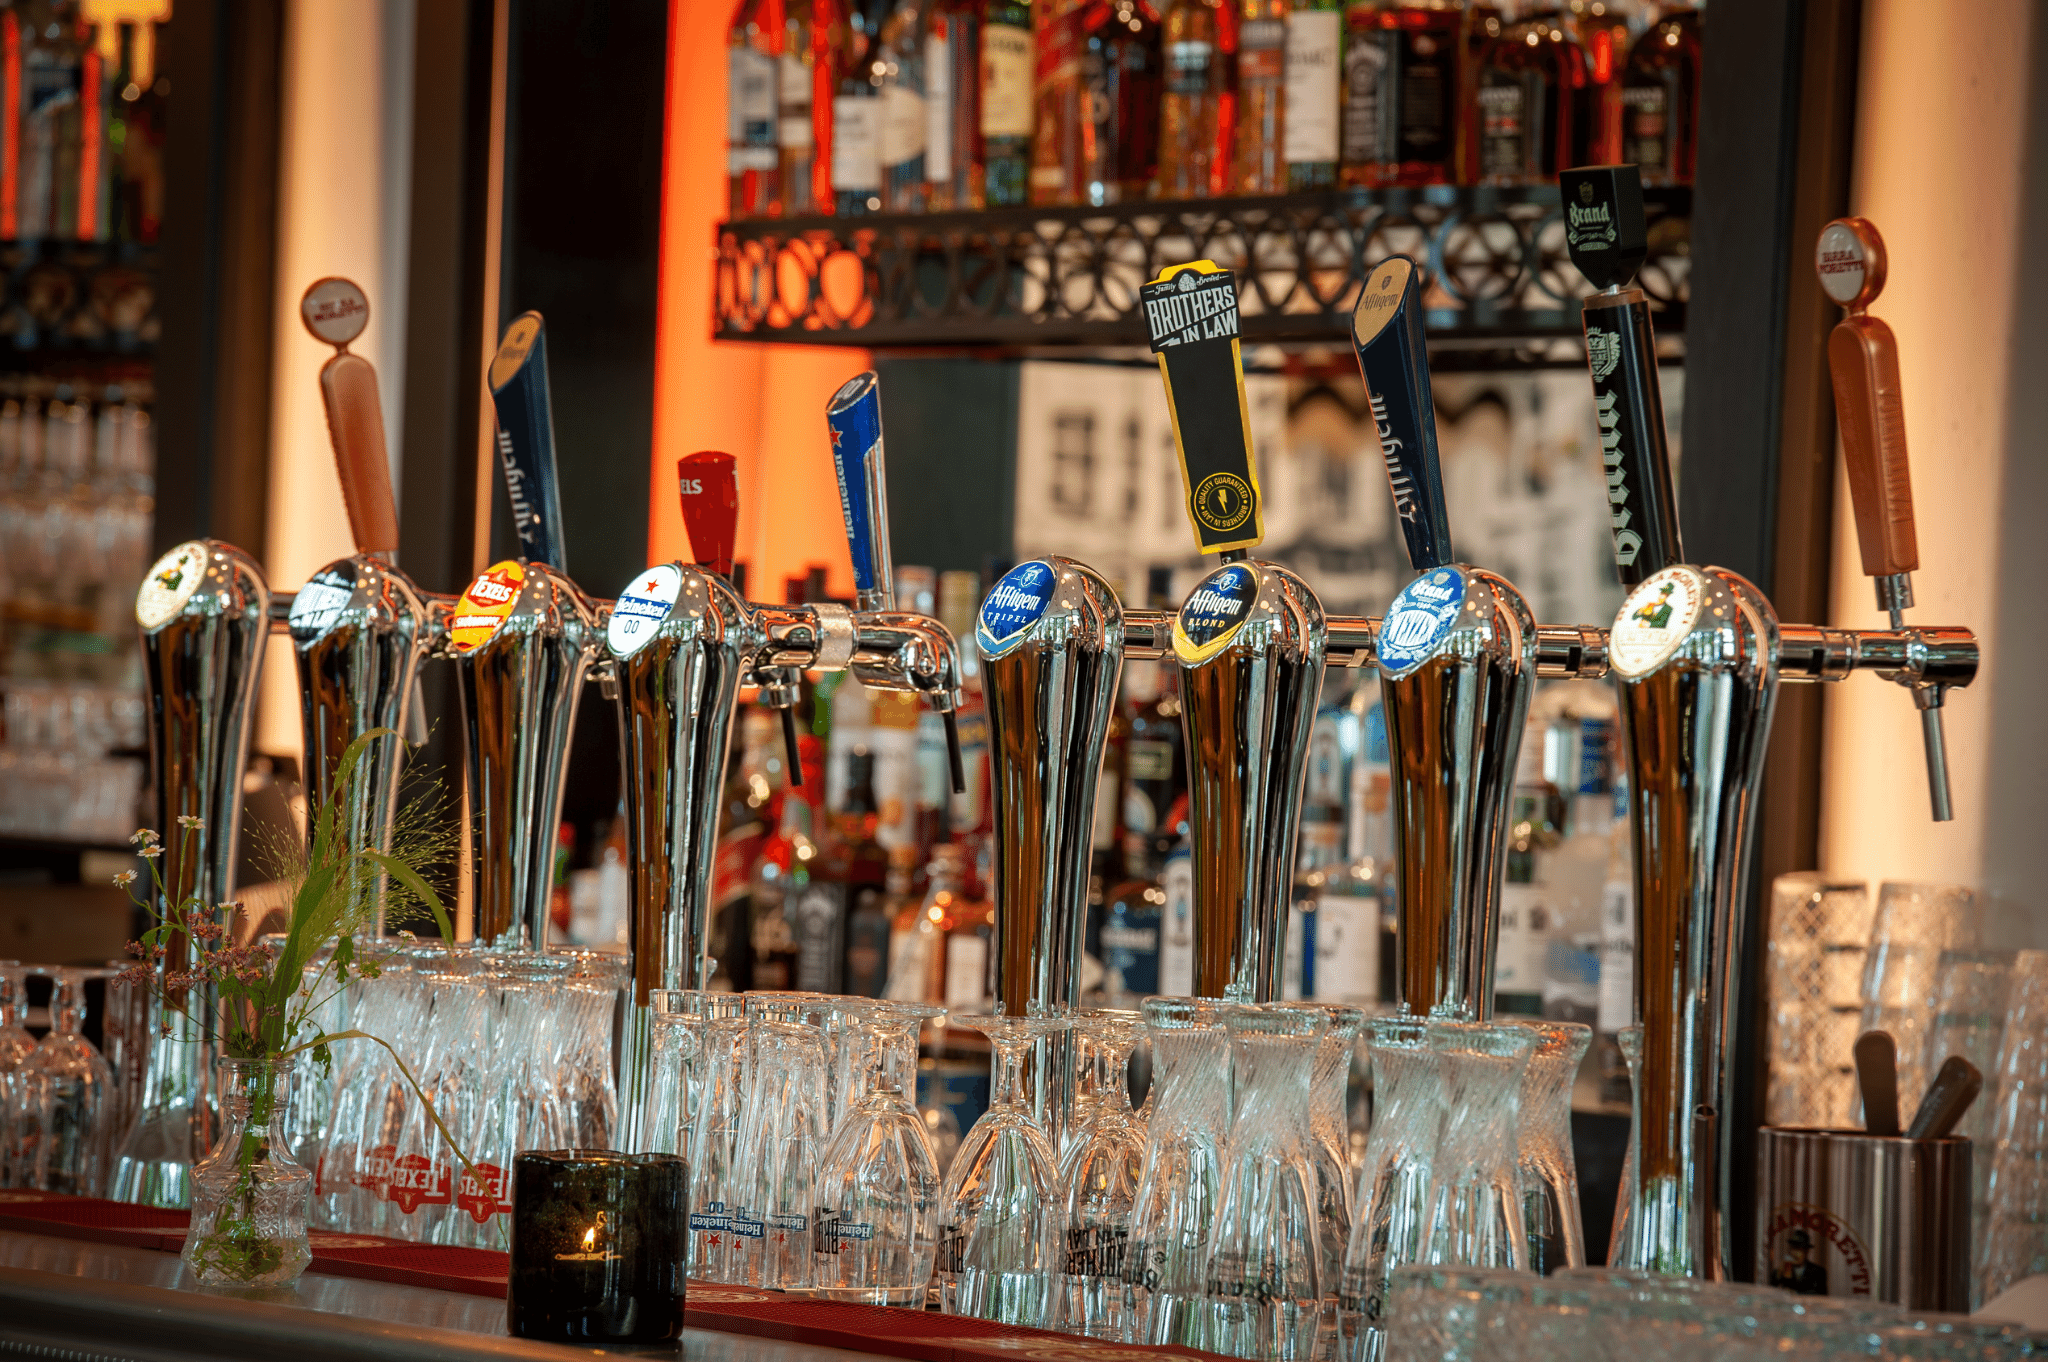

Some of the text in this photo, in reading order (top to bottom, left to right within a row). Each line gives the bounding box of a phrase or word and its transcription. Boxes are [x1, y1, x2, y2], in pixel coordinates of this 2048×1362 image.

[1569, 201, 1611, 228] Brand
[1155, 282, 1177, 296] Family
[1145, 285, 1236, 341] BROTHERS
[1181, 307, 1238, 344] IN LAW
[1198, 476, 1249, 505] QUALITY GUARANTEED
[1201, 505, 1249, 528] BROTHERS IN LAW
[470, 574, 514, 603] TEXELS
[985, 584, 1041, 612] Affligem
[1410, 579, 1455, 601] Brand
[1184, 589, 1243, 617] Affligem
[987, 611, 1027, 624] TRIPEL
[1187, 618, 1226, 628] BLOND
[1790, 1207, 1870, 1295] MORETTI
